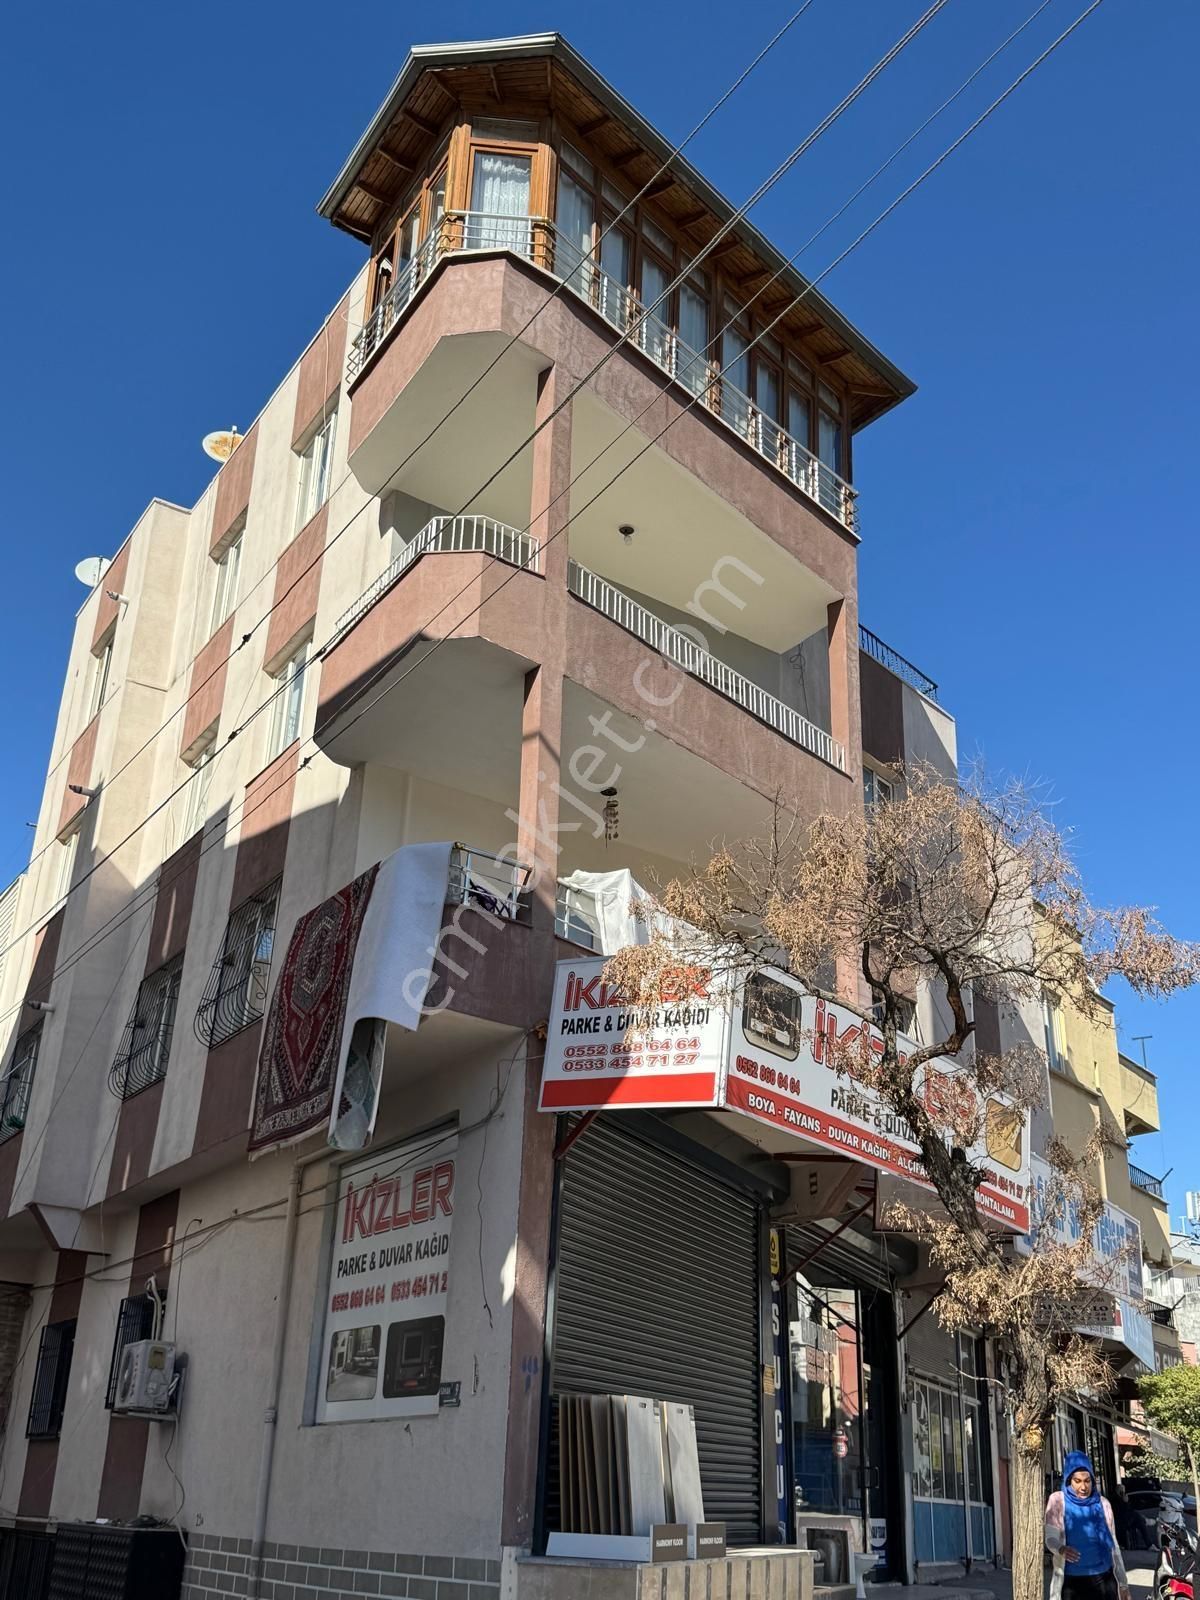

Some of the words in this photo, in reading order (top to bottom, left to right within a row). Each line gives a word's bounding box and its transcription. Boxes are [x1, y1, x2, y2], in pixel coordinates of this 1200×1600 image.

[560, 1016, 601, 1035] PARKE
[604, 1015, 613, 1032] &
[617, 1011, 660, 1032] DUVAR
[562, 1058, 606, 1073] 0533
[608, 1056, 644, 1071] 454
[646, 1054, 669, 1068] 71
[672, 1052, 701, 1066] 27
[564, 1044, 608, 1058] 0552
[648, 1037, 673, 1052] 64
[674, 1037, 701, 1051] 64
[735, 1055, 759, 1079] 0552
[777, 1071, 789, 1092] 64
[789, 1076, 801, 1097] 64
[747, 1092, 777, 1116] BOYA
[783, 1106, 822, 1134] FAYANS
[827, 1125, 860, 1149] DUVAR
[830, 1089, 870, 1124] PARKE
[342, 1160, 455, 1244] İKİZLER
[337, 1253, 368, 1278] PARKE
[369, 1251, 376, 1271] &
[379, 1243, 413, 1269] DUVAR
[331, 1291, 349, 1313] 0552
[391, 1278, 411, 1302] 0533
[429, 1271, 440, 1295] 71
